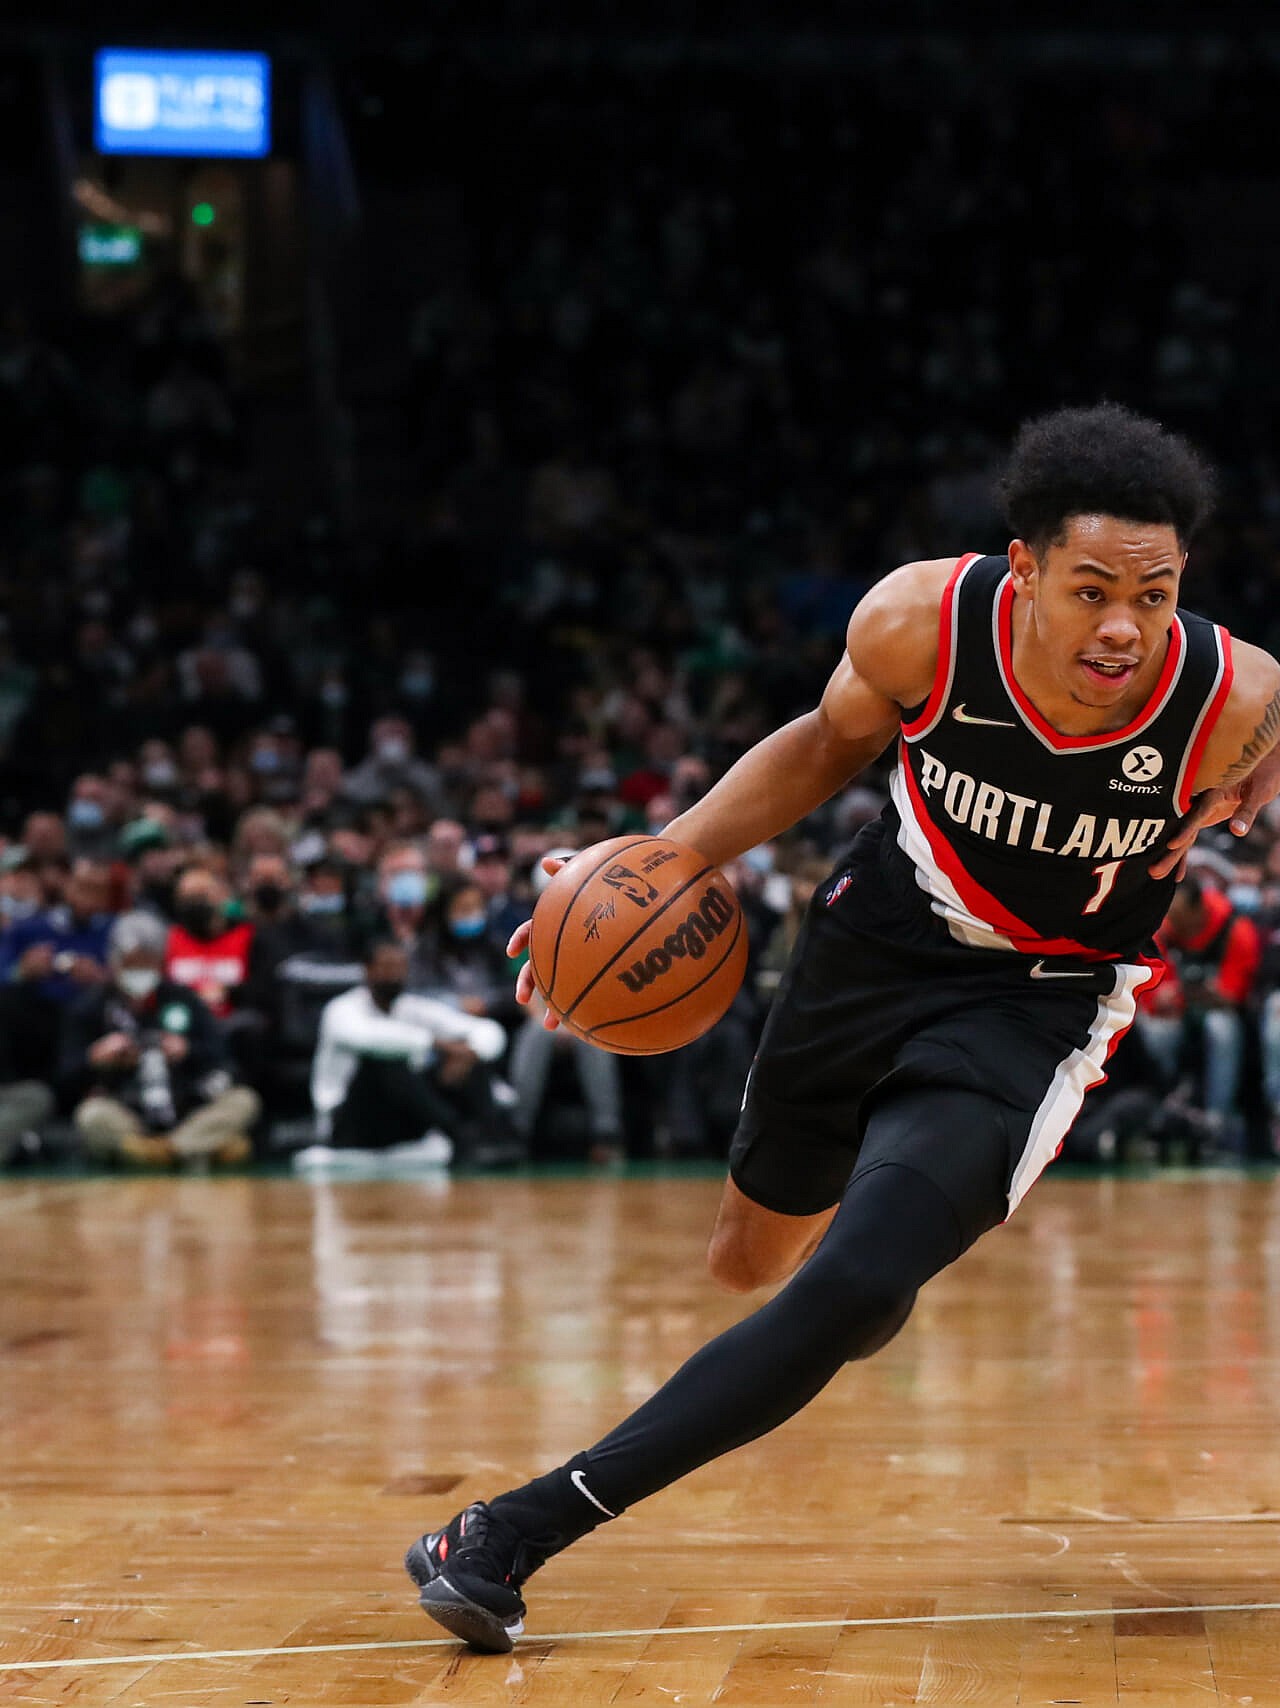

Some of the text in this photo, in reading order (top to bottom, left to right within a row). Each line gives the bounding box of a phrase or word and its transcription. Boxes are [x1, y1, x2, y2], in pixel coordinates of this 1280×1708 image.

[920, 749, 1166, 858] PORTLAND
[1108, 778, 1164, 794] StormX
[1081, 860, 1126, 916] 1
[616, 886, 735, 993] Wilson
